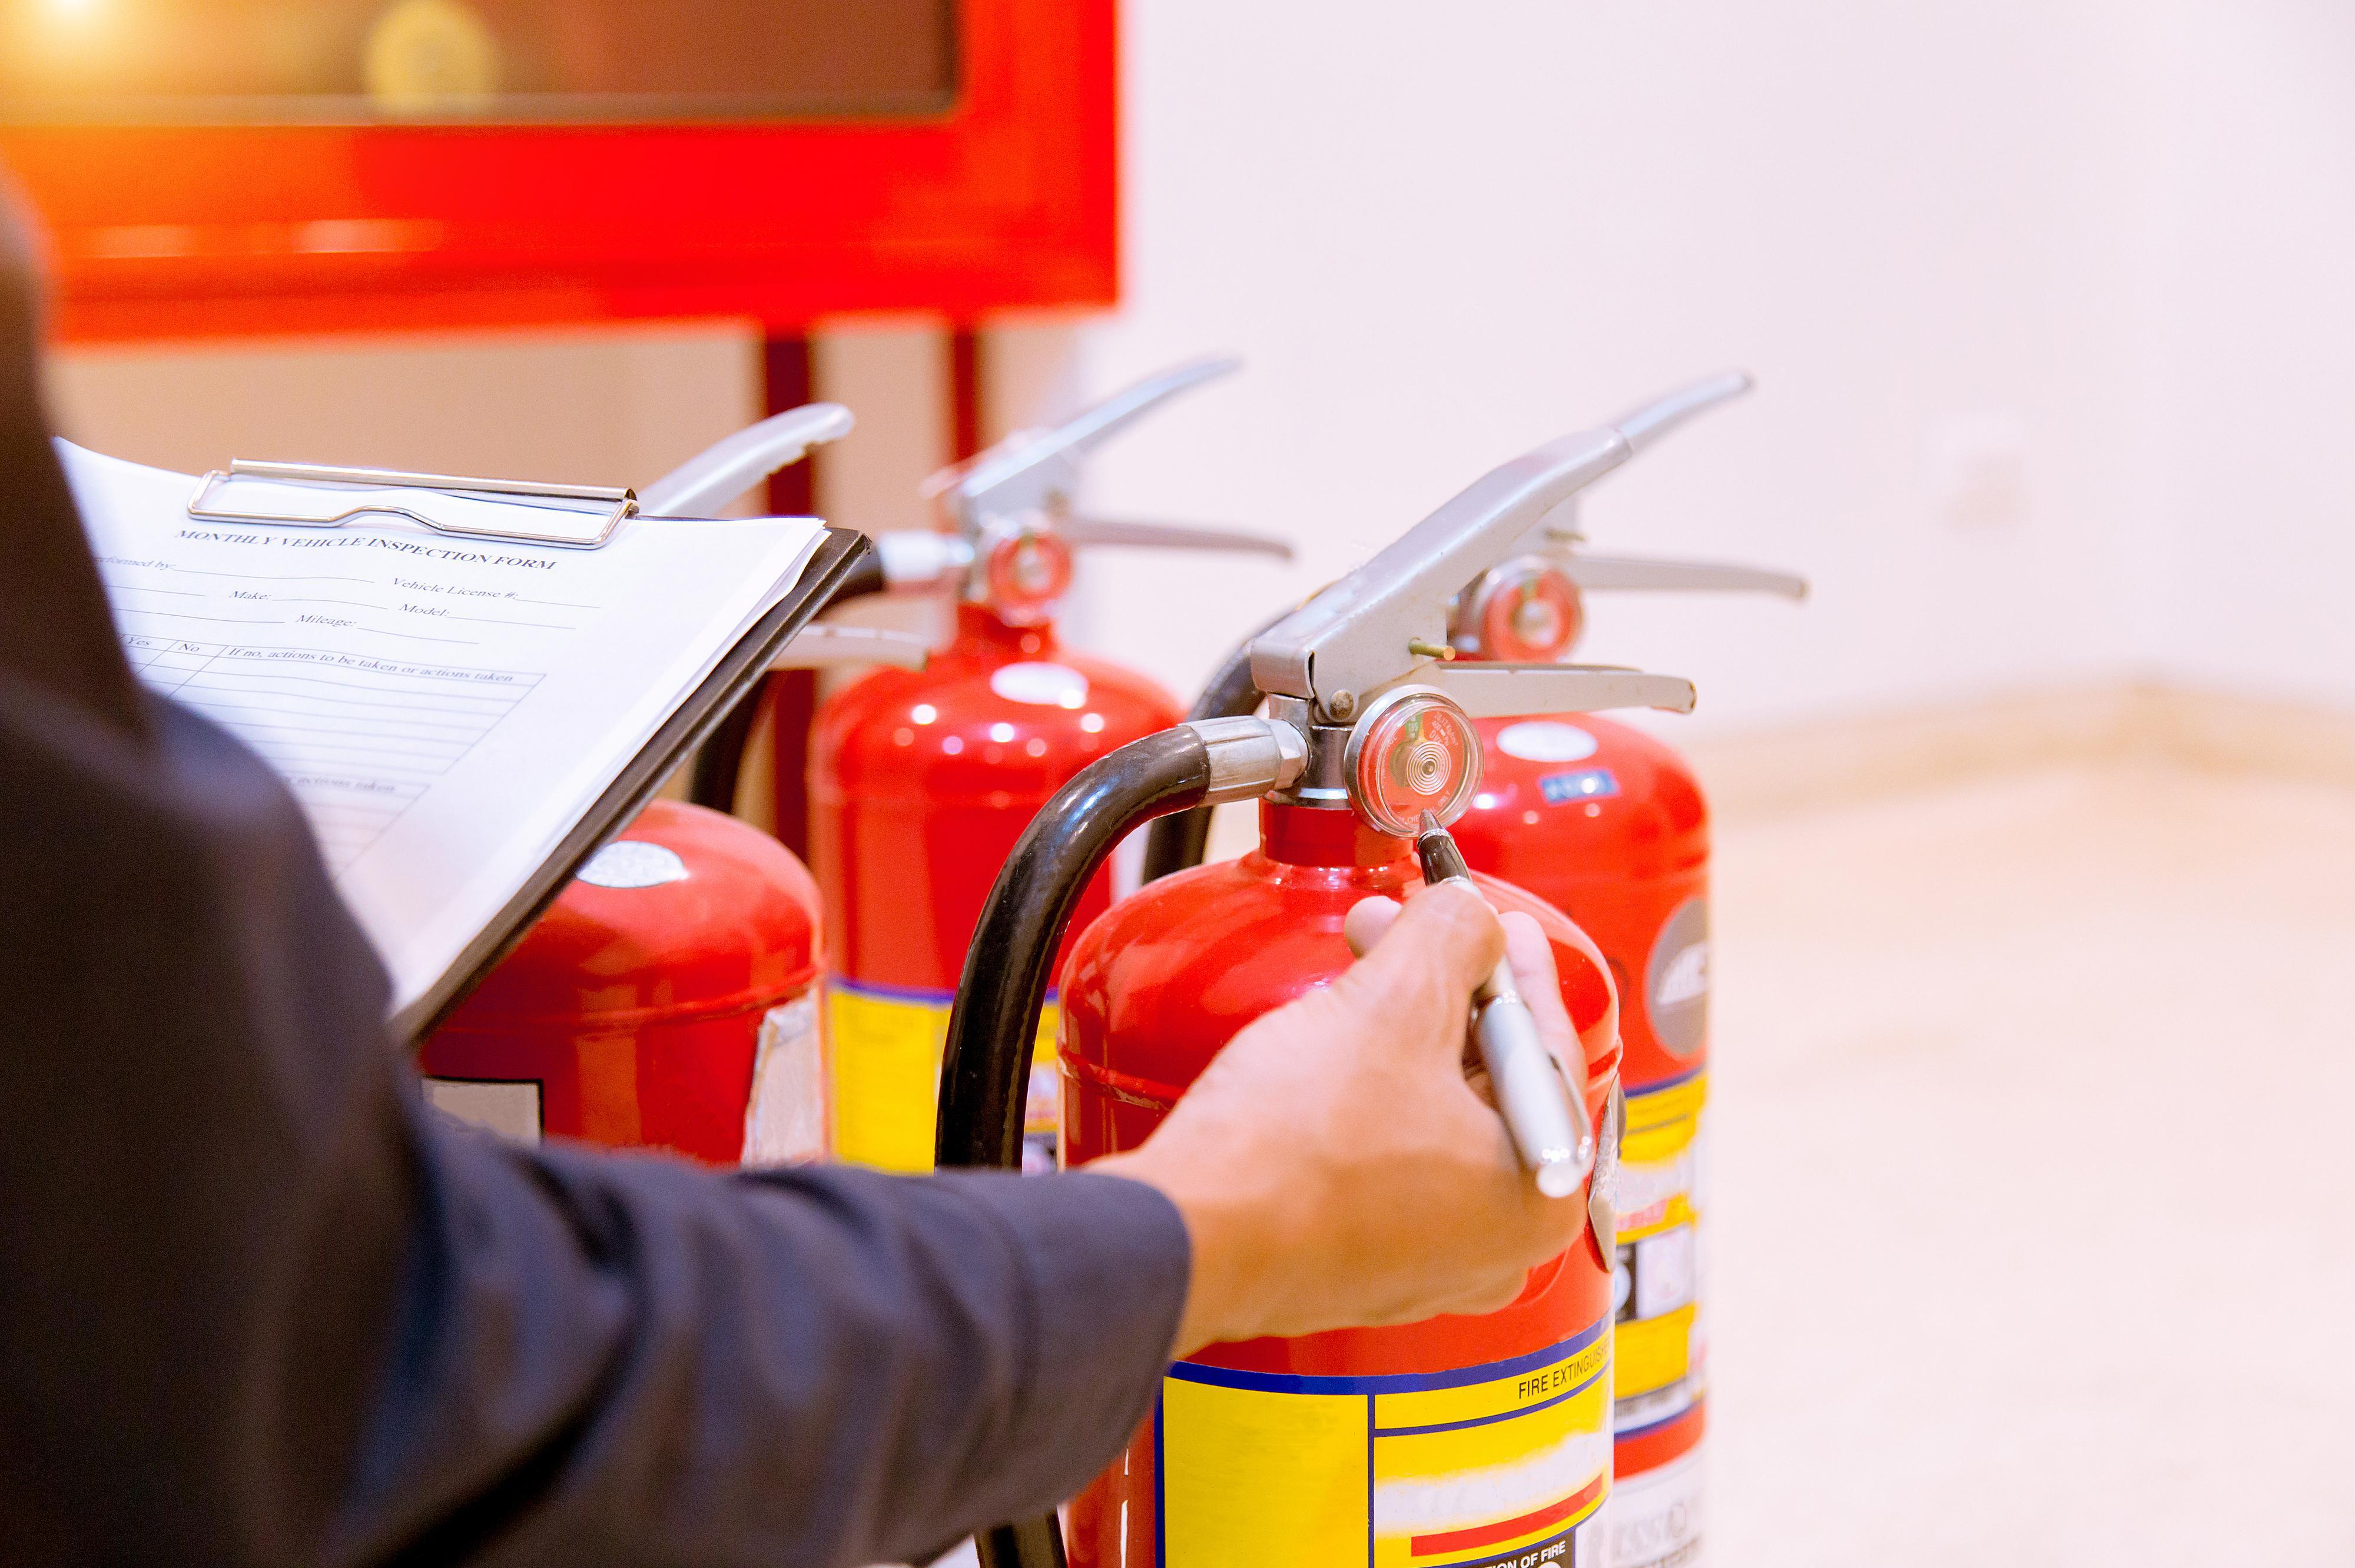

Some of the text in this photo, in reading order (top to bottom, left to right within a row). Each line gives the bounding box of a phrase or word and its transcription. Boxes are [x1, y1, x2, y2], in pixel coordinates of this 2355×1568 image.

[175, 530, 557, 570] MONTHLY VEHICLE INSPECTION FORM
[229, 590, 271, 600] Make:
[393, 577, 443, 593] Vehicle
[447, 586, 501, 598] License
[399, 603, 450, 617] Model:
[295, 614, 357, 627] Mileage:
[127, 636, 152, 646] Yes
[178, 643, 200, 652] No
[228, 647, 244, 656] If
[243, 650, 263, 658] no,
[267, 650, 316, 660] actions
[337, 655, 356, 665] be
[358, 660, 398, 672] taken
[420, 668, 470, 679] actions
[474, 673, 514, 682] taken
[1519, 1374, 1548, 1399] FIRE
[1520, 1552, 1538, 1568] OF
[1540, 1540, 1566, 1563] FIRE
